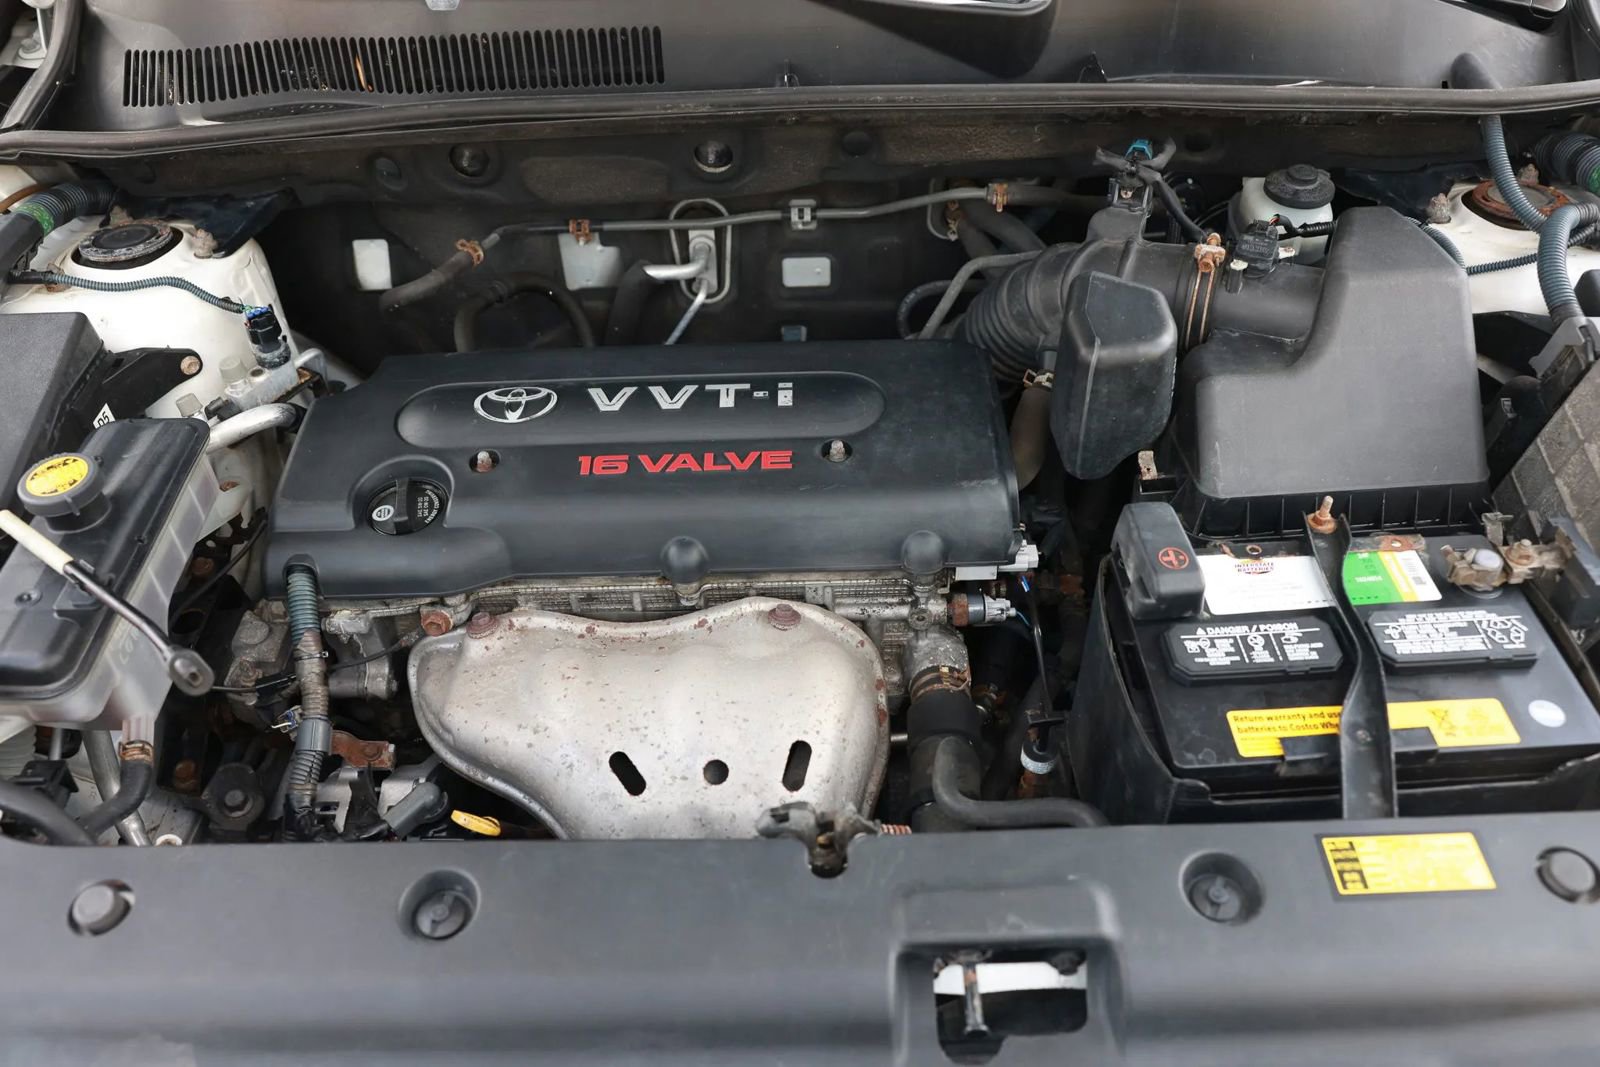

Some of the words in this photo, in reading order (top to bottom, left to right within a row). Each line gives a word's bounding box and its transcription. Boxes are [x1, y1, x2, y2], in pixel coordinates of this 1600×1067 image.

[587, 382, 793, 411] VVT-i
[578, 454, 629, 475] 16
[637, 450, 793, 473] VALVE
[1206, 625, 1249, 635] DANGER
[1259, 622, 1299, 632] POISON
[1266, 713, 1307, 721] warranty
[1309, 711, 1325, 719] and
[1237, 725, 1277, 734] batteries
[1289, 723, 1319, 731] Costco
